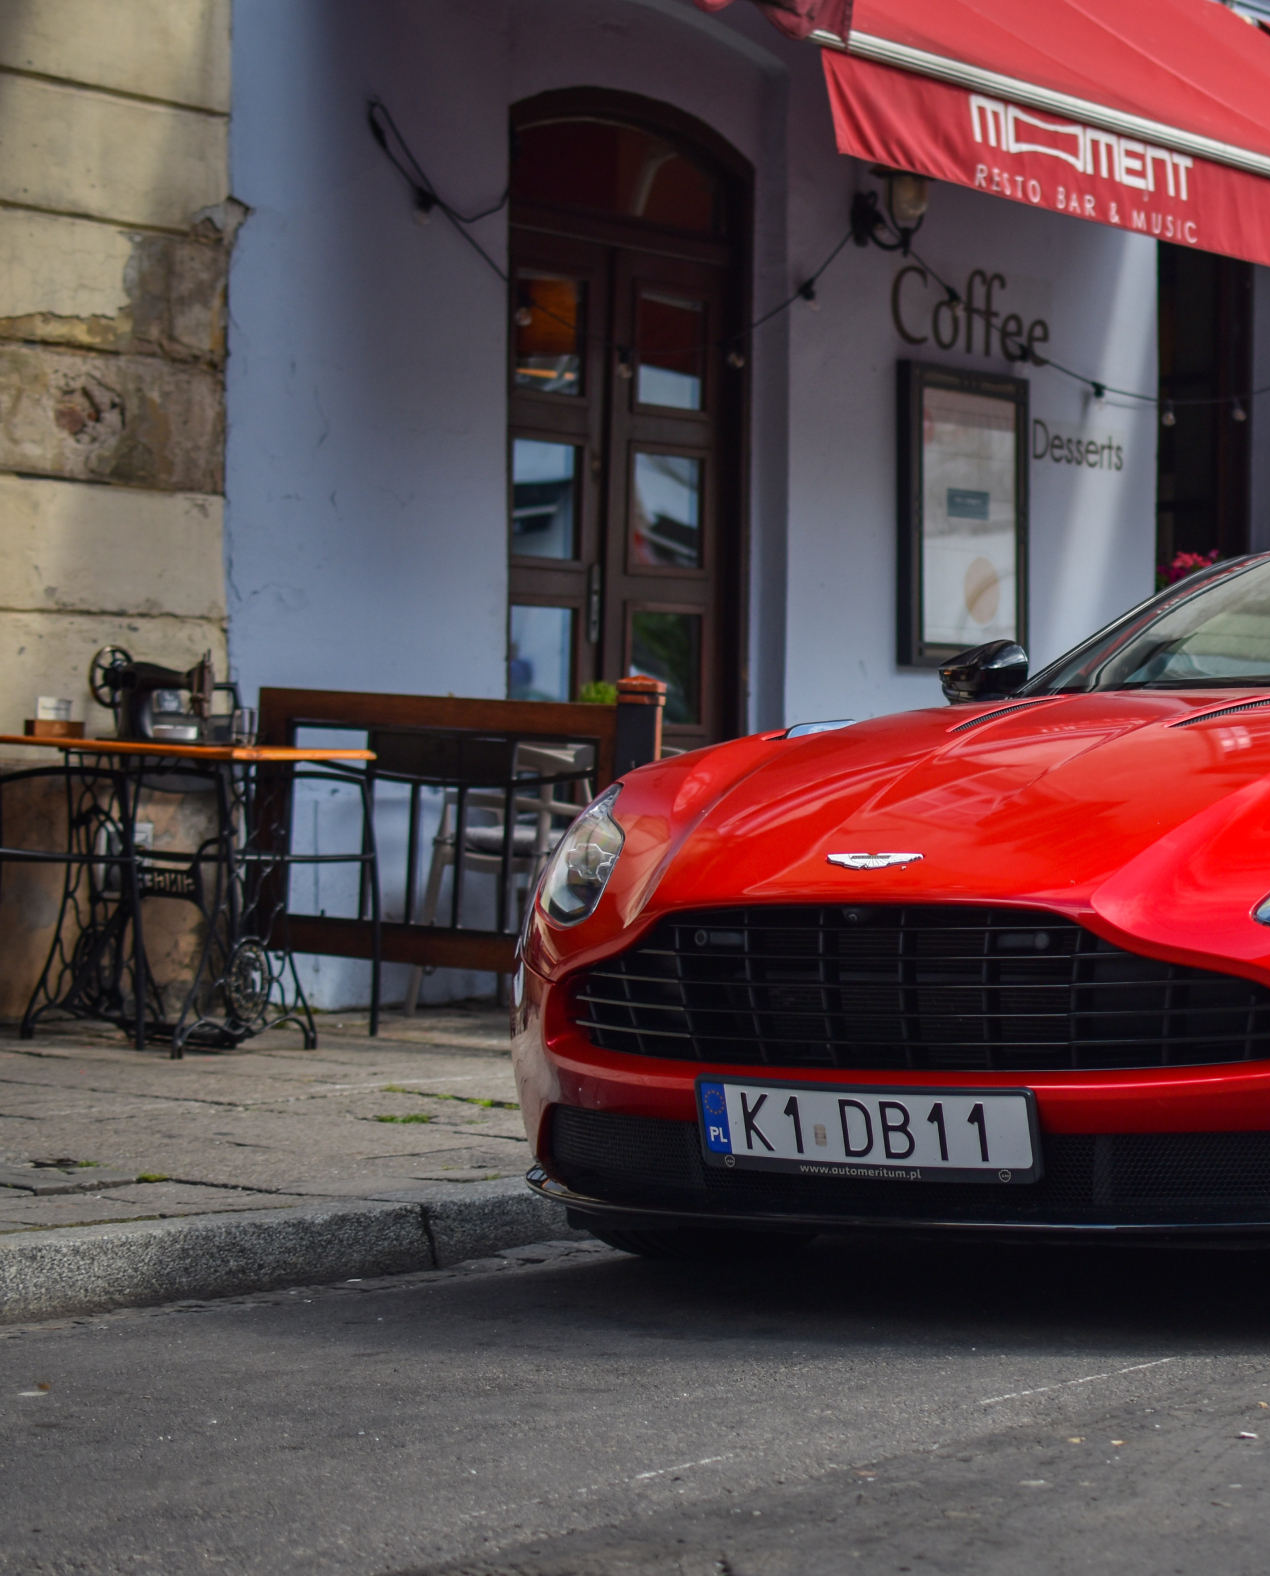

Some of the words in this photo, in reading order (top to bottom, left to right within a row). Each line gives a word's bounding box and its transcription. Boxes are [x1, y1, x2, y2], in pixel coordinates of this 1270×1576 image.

[969, 94, 1194, 201] MOMENT
[975, 163, 1042, 203] RESTO
[1056, 186, 1096, 217] BAR
[1109, 202, 1121, 224] &
[1131, 209, 1198, 244] MUSIC
[891, 265, 1050, 367] Coffee
[1032, 418, 1124, 471] Desserts
[709, 1126, 728, 1143] PL
[740, 1092, 805, 1154] K1
[838, 1098, 990, 1162] DB11
[799, 1164, 922, 1180] www.automeritum.pl
